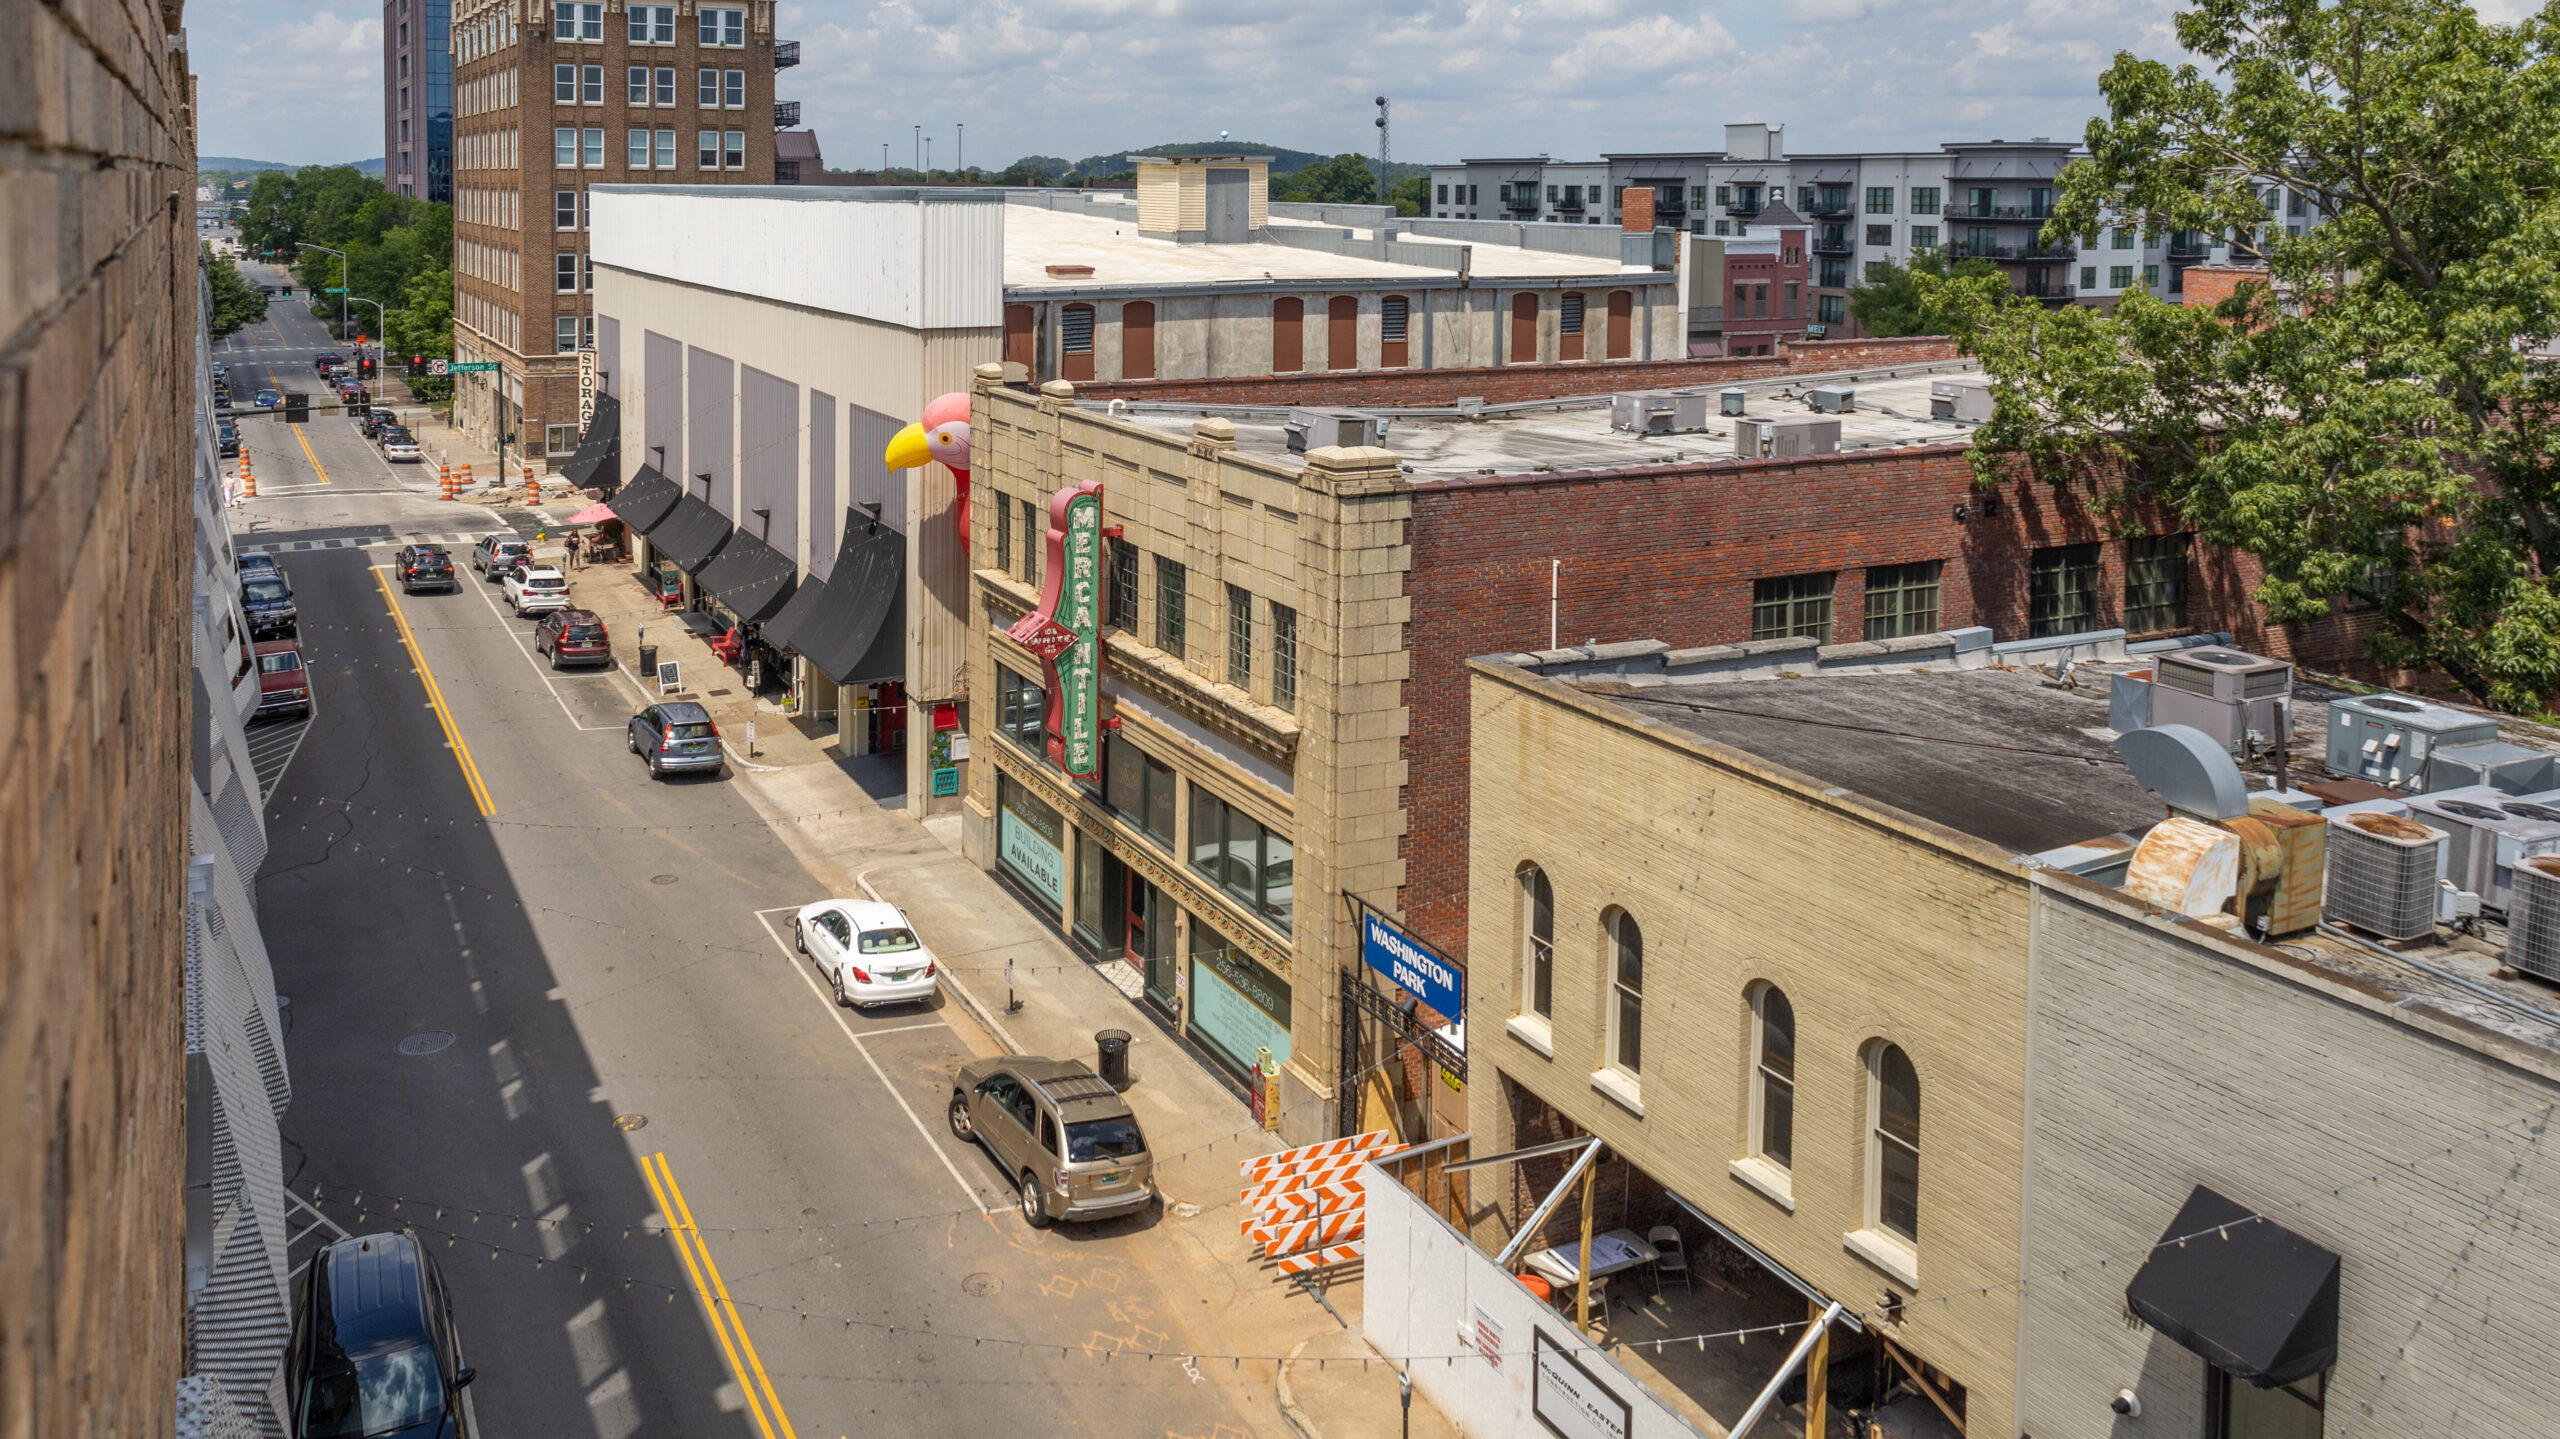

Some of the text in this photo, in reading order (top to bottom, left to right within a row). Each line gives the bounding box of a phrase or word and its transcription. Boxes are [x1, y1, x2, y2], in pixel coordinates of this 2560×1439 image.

[1807, 324, 1826, 334] MELT
[449, 362, 497, 372] Jefferson St
[1031, 634, 1071, 646] WHITE
[1072, 506, 1095, 765] MERCANTILE
[1011, 843, 1058, 893] AVAILABLE
[1015, 825, 1054, 868] BUILDING
[1370, 922, 1453, 992] WASHINGTON
[1393, 960, 1427, 998] PARK
[1216, 957, 1274, 1011] 256-536-8809
[1539, 1360, 1581, 1400] McQUINN
[1586, 1402, 1624, 1435] EASTEP
[1541, 1371, 1591, 1418] CONSTRUCTION
